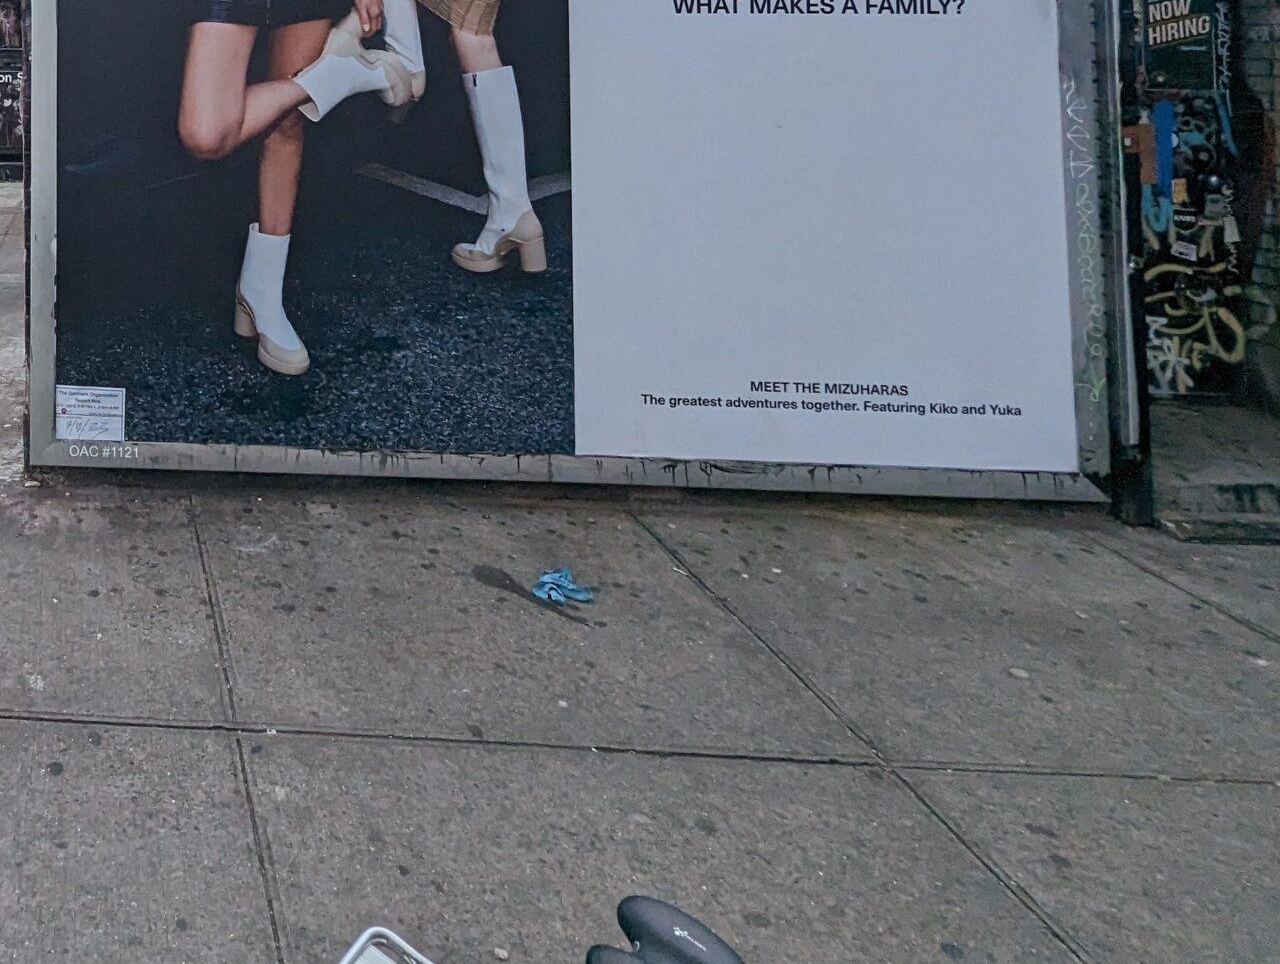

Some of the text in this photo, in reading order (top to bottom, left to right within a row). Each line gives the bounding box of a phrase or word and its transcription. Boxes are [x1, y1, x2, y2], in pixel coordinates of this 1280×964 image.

[1148, 15, 1210, 45] HIRING
[750, 380, 909, 396] MEET THE MIZUHARAS
[641, 394, 1022, 417] The greatest adventures together. Featuring Kiko and Yuka
[70, 446, 139, 459] OAC #1121
